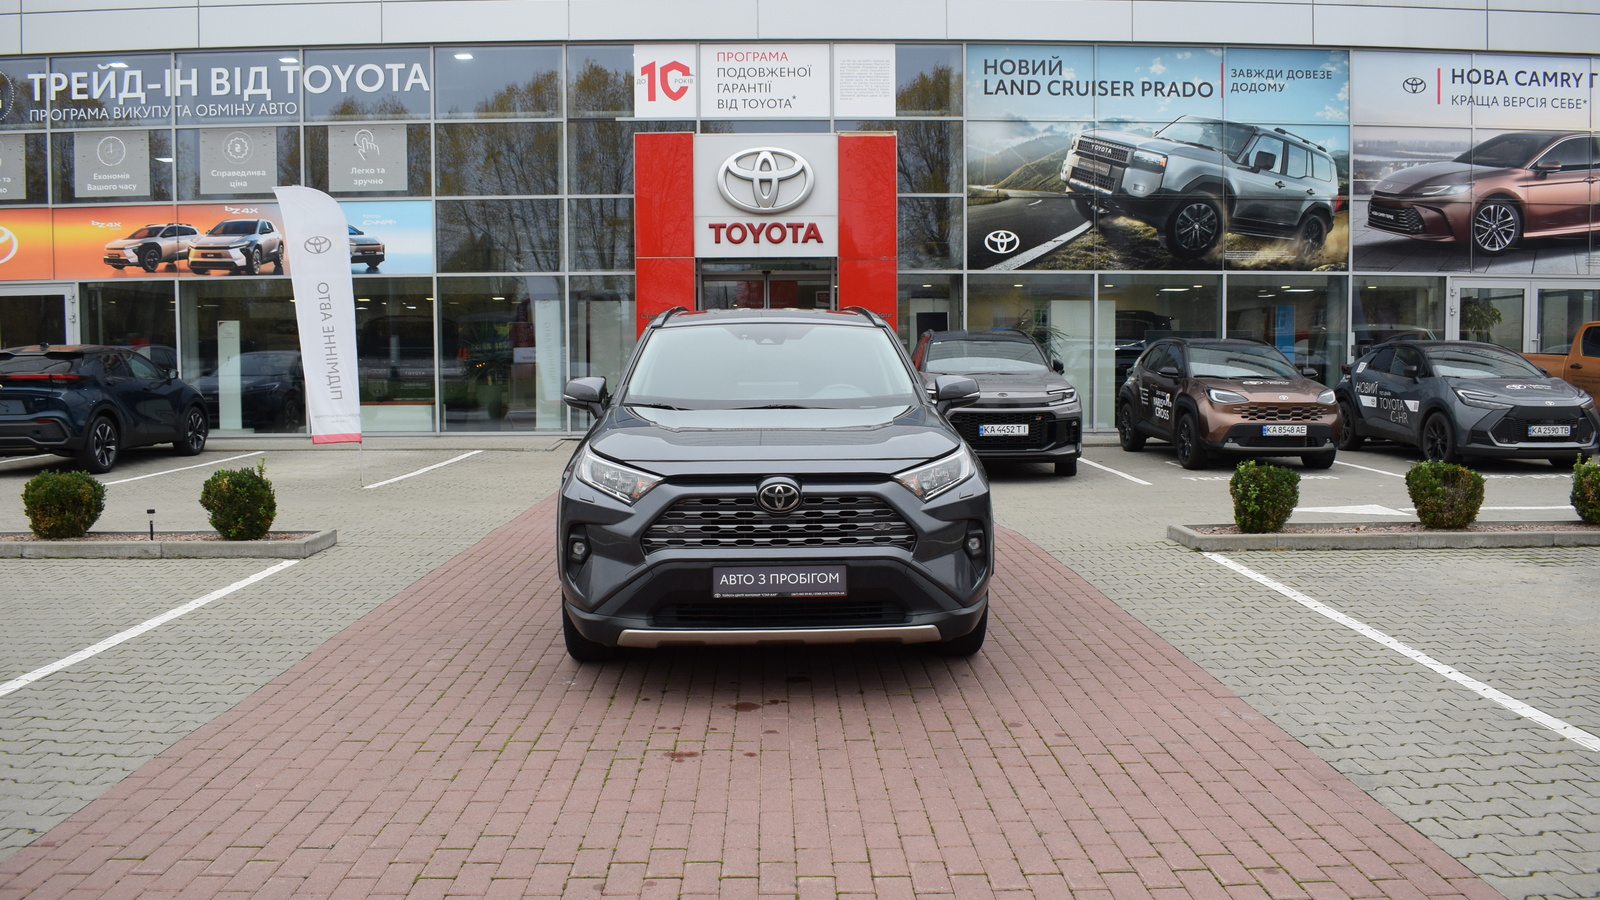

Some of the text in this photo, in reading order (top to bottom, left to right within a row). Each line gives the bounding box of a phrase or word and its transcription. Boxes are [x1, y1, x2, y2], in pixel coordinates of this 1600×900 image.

[716, 51, 789, 62] ПРОГРАМА
[716, 65, 812, 79] ПОДОВЖЕНОЇ
[983, 55, 1063, 76] НОВИЙ
[1230, 68, 1332, 81] ЗАВЖДИ ДОВЕЗЕ
[1451, 68, 1509, 86] НОВА
[1514, 70, 1584, 88] CAMRY
[27, 63, 430, 105] ТРЕЙД-ІН ВІД TOYOTA
[716, 80, 772, 94] ГАРАНТІЇ
[983, 79, 1214, 98] LAND CRUISER PRADO
[1230, 82, 1286, 93] ДОДОМУ
[717, 98, 739, 110] ВІД
[1451, 94, 1499, 109] КРАЩА
[1503, 97, 1547, 108] ВЕРСІЯ
[29, 102, 298, 122] ПРОГРАМА ВИКУПУ ТА ОБМІНУ АВТО
[1091, 144, 1112, 154] TOYOTA
[93, 172, 131, 180] Економія
[210, 169, 267, 179] Справедлива
[350, 166, 375, 175] Легко
[87, 183, 137, 192] Вашого часу
[229, 180, 248, 189] ціна
[353, 177, 384, 186] зручно
[708, 221, 824, 245] TOYOTA
[1354, 381, 1379, 394] НОВИЙ
[1379, 397, 1405, 411] TOYOTA
[1154, 407, 1170, 420] CROSS
[1390, 410, 1409, 424] C-HR
[983, 425, 996, 434] KA
[996, 425, 1015, 434] 4452
[1266, 426, 1306, 434] KA 8548 AE
[1532, 426, 1543, 435] KA
[1543, 426, 1559, 435] 2590
[719, 572, 840, 585] АВТО З ПРОБІГОМ
